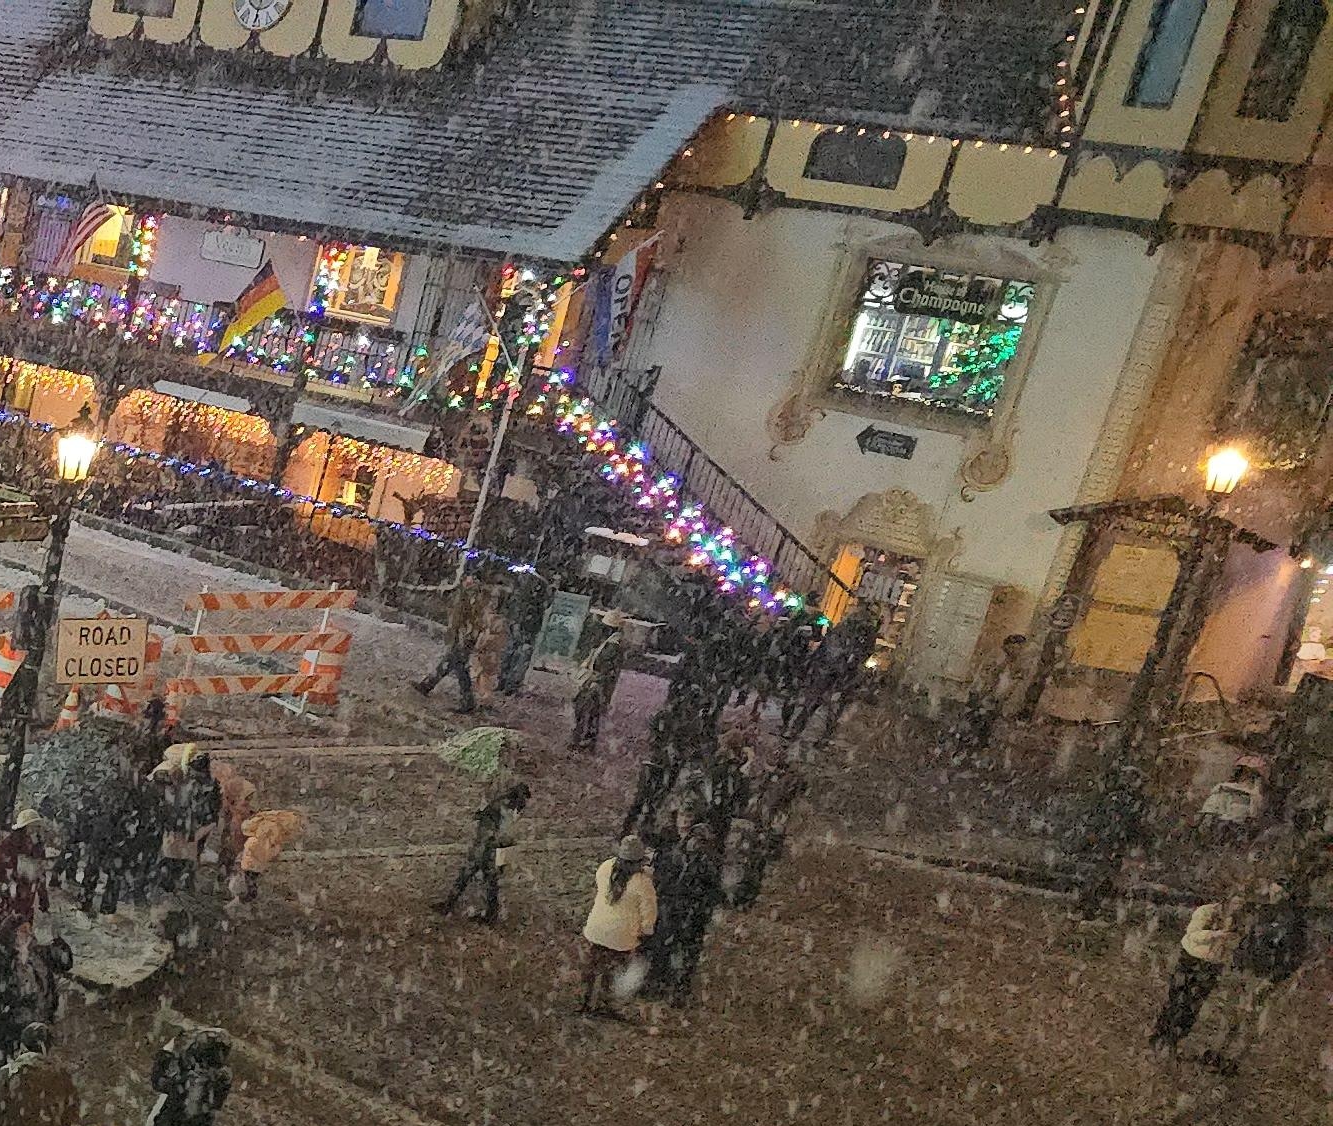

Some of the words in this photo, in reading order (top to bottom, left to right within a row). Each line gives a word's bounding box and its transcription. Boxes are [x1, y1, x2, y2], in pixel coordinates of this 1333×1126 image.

[899, 287, 984, 316] Champagne
[79, 626, 131, 646] ROAD
[65, 657, 139, 677] CLOSED
